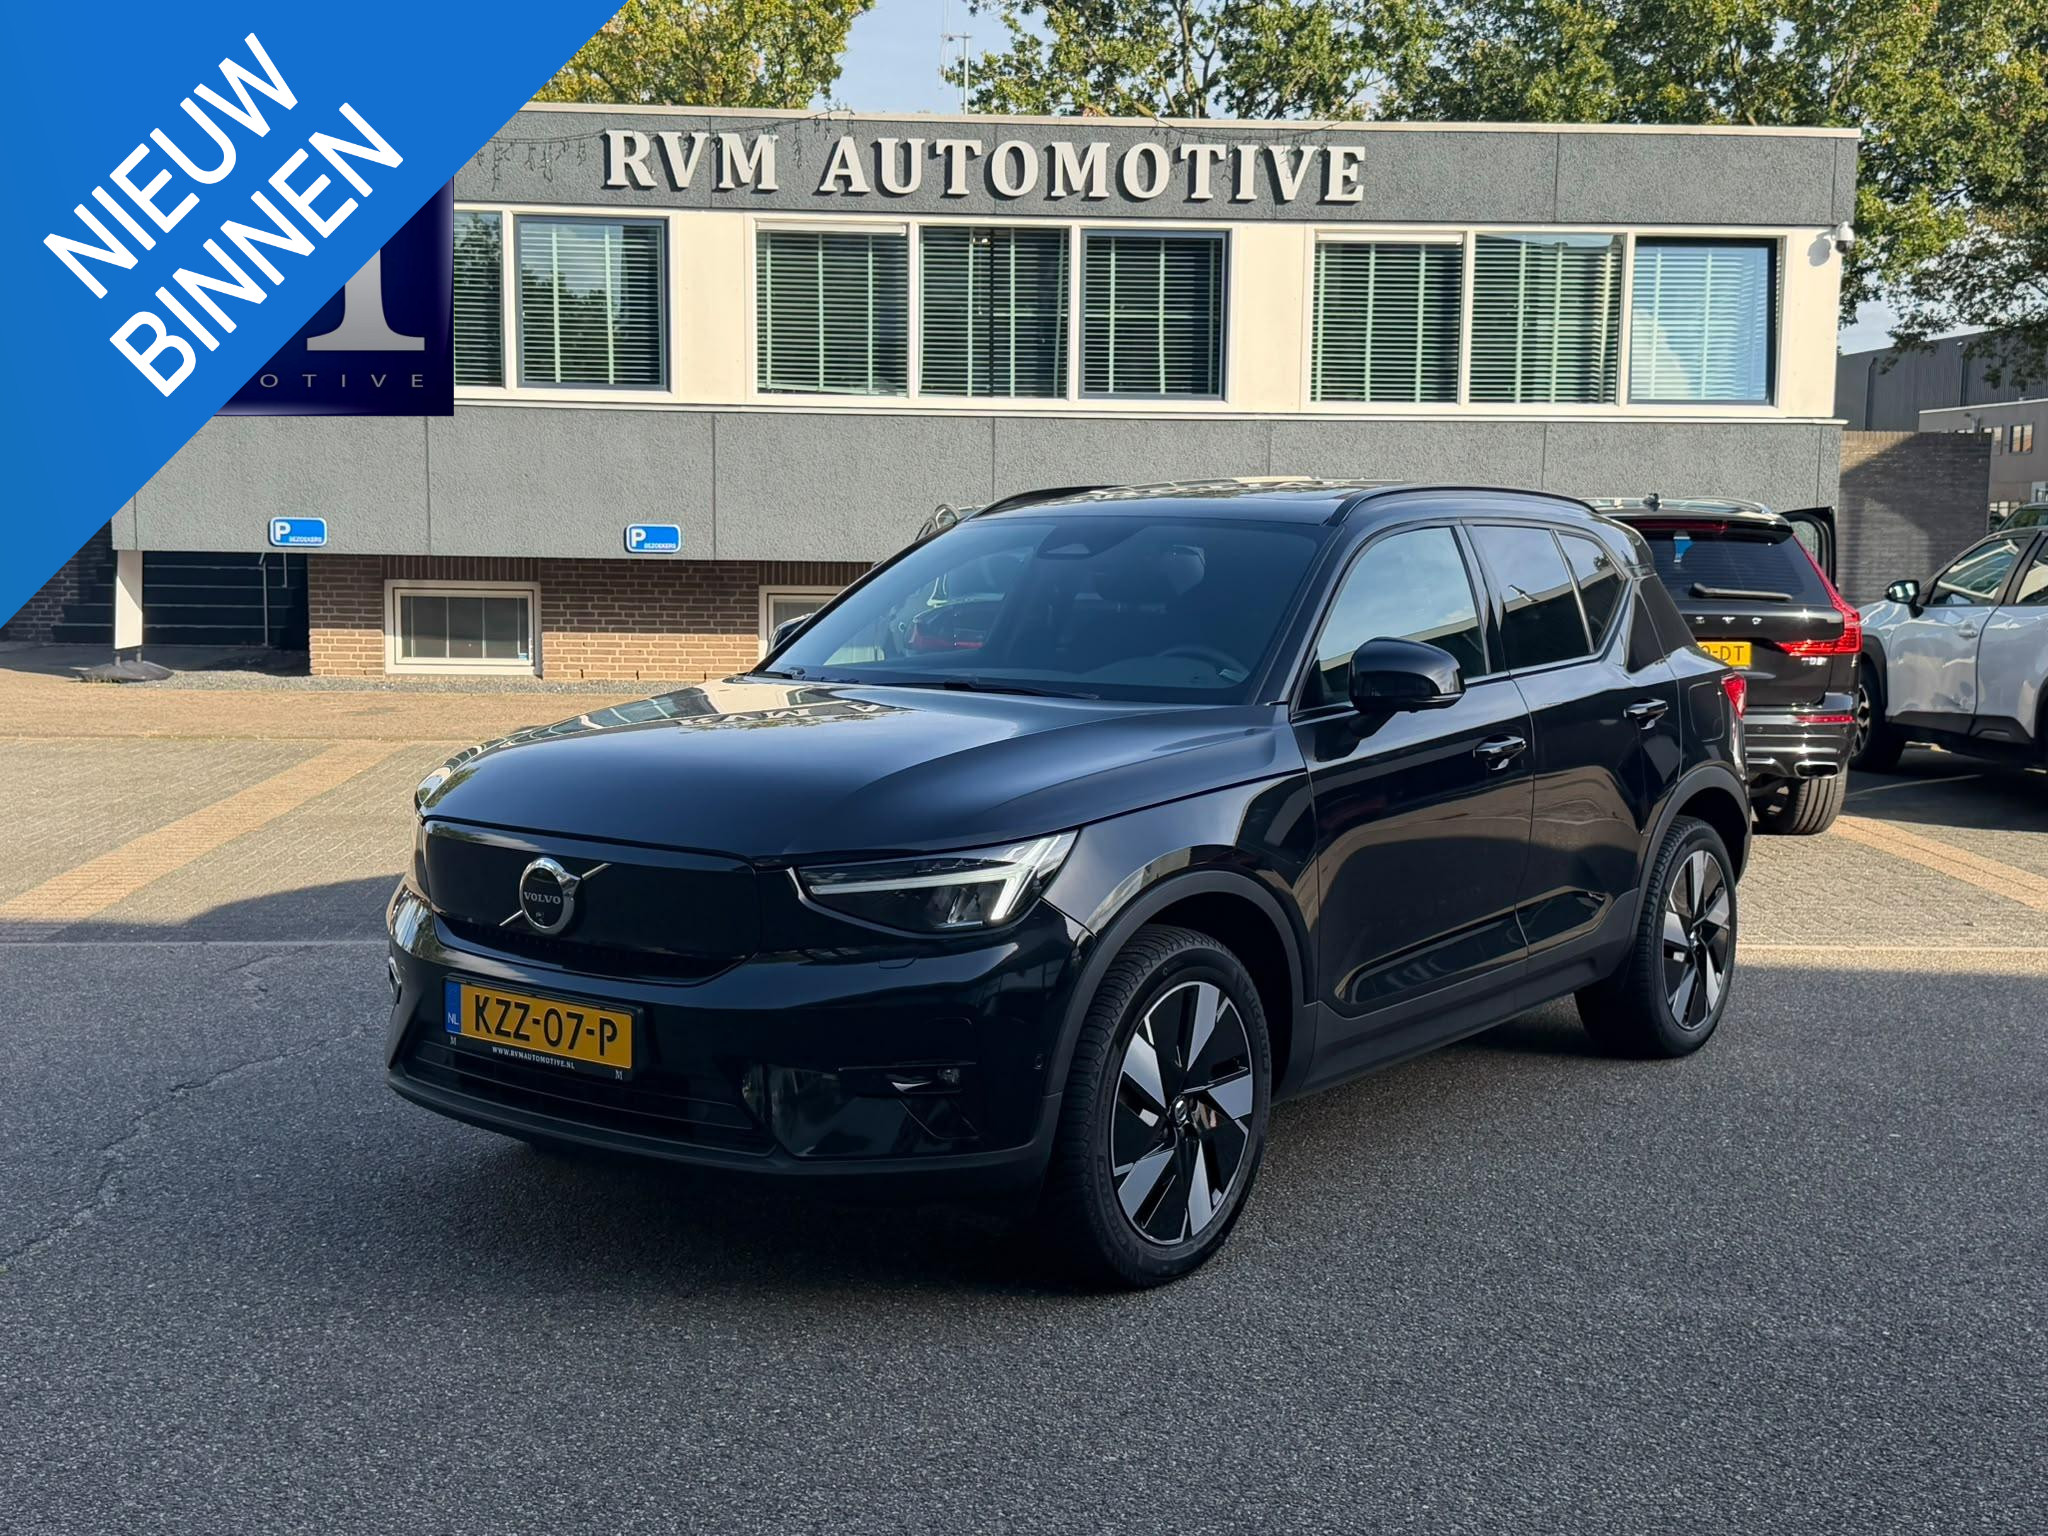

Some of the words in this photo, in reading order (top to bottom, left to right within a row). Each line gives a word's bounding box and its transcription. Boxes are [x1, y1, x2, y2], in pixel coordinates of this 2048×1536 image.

[606, 130, 779, 191] RVM
[818, 136, 1366, 203] AUTOMOTIVE
[275, 522, 291, 541] P
[631, 528, 646, 547] P
[523, 891, 562, 905] VOLVO
[447, 1012, 460, 1026] NL
[474, 994, 618, 1057] KZZ-07-P
[492, 1046, 576, 1070] WWW.RVMAUTOMOTIVE.NL
